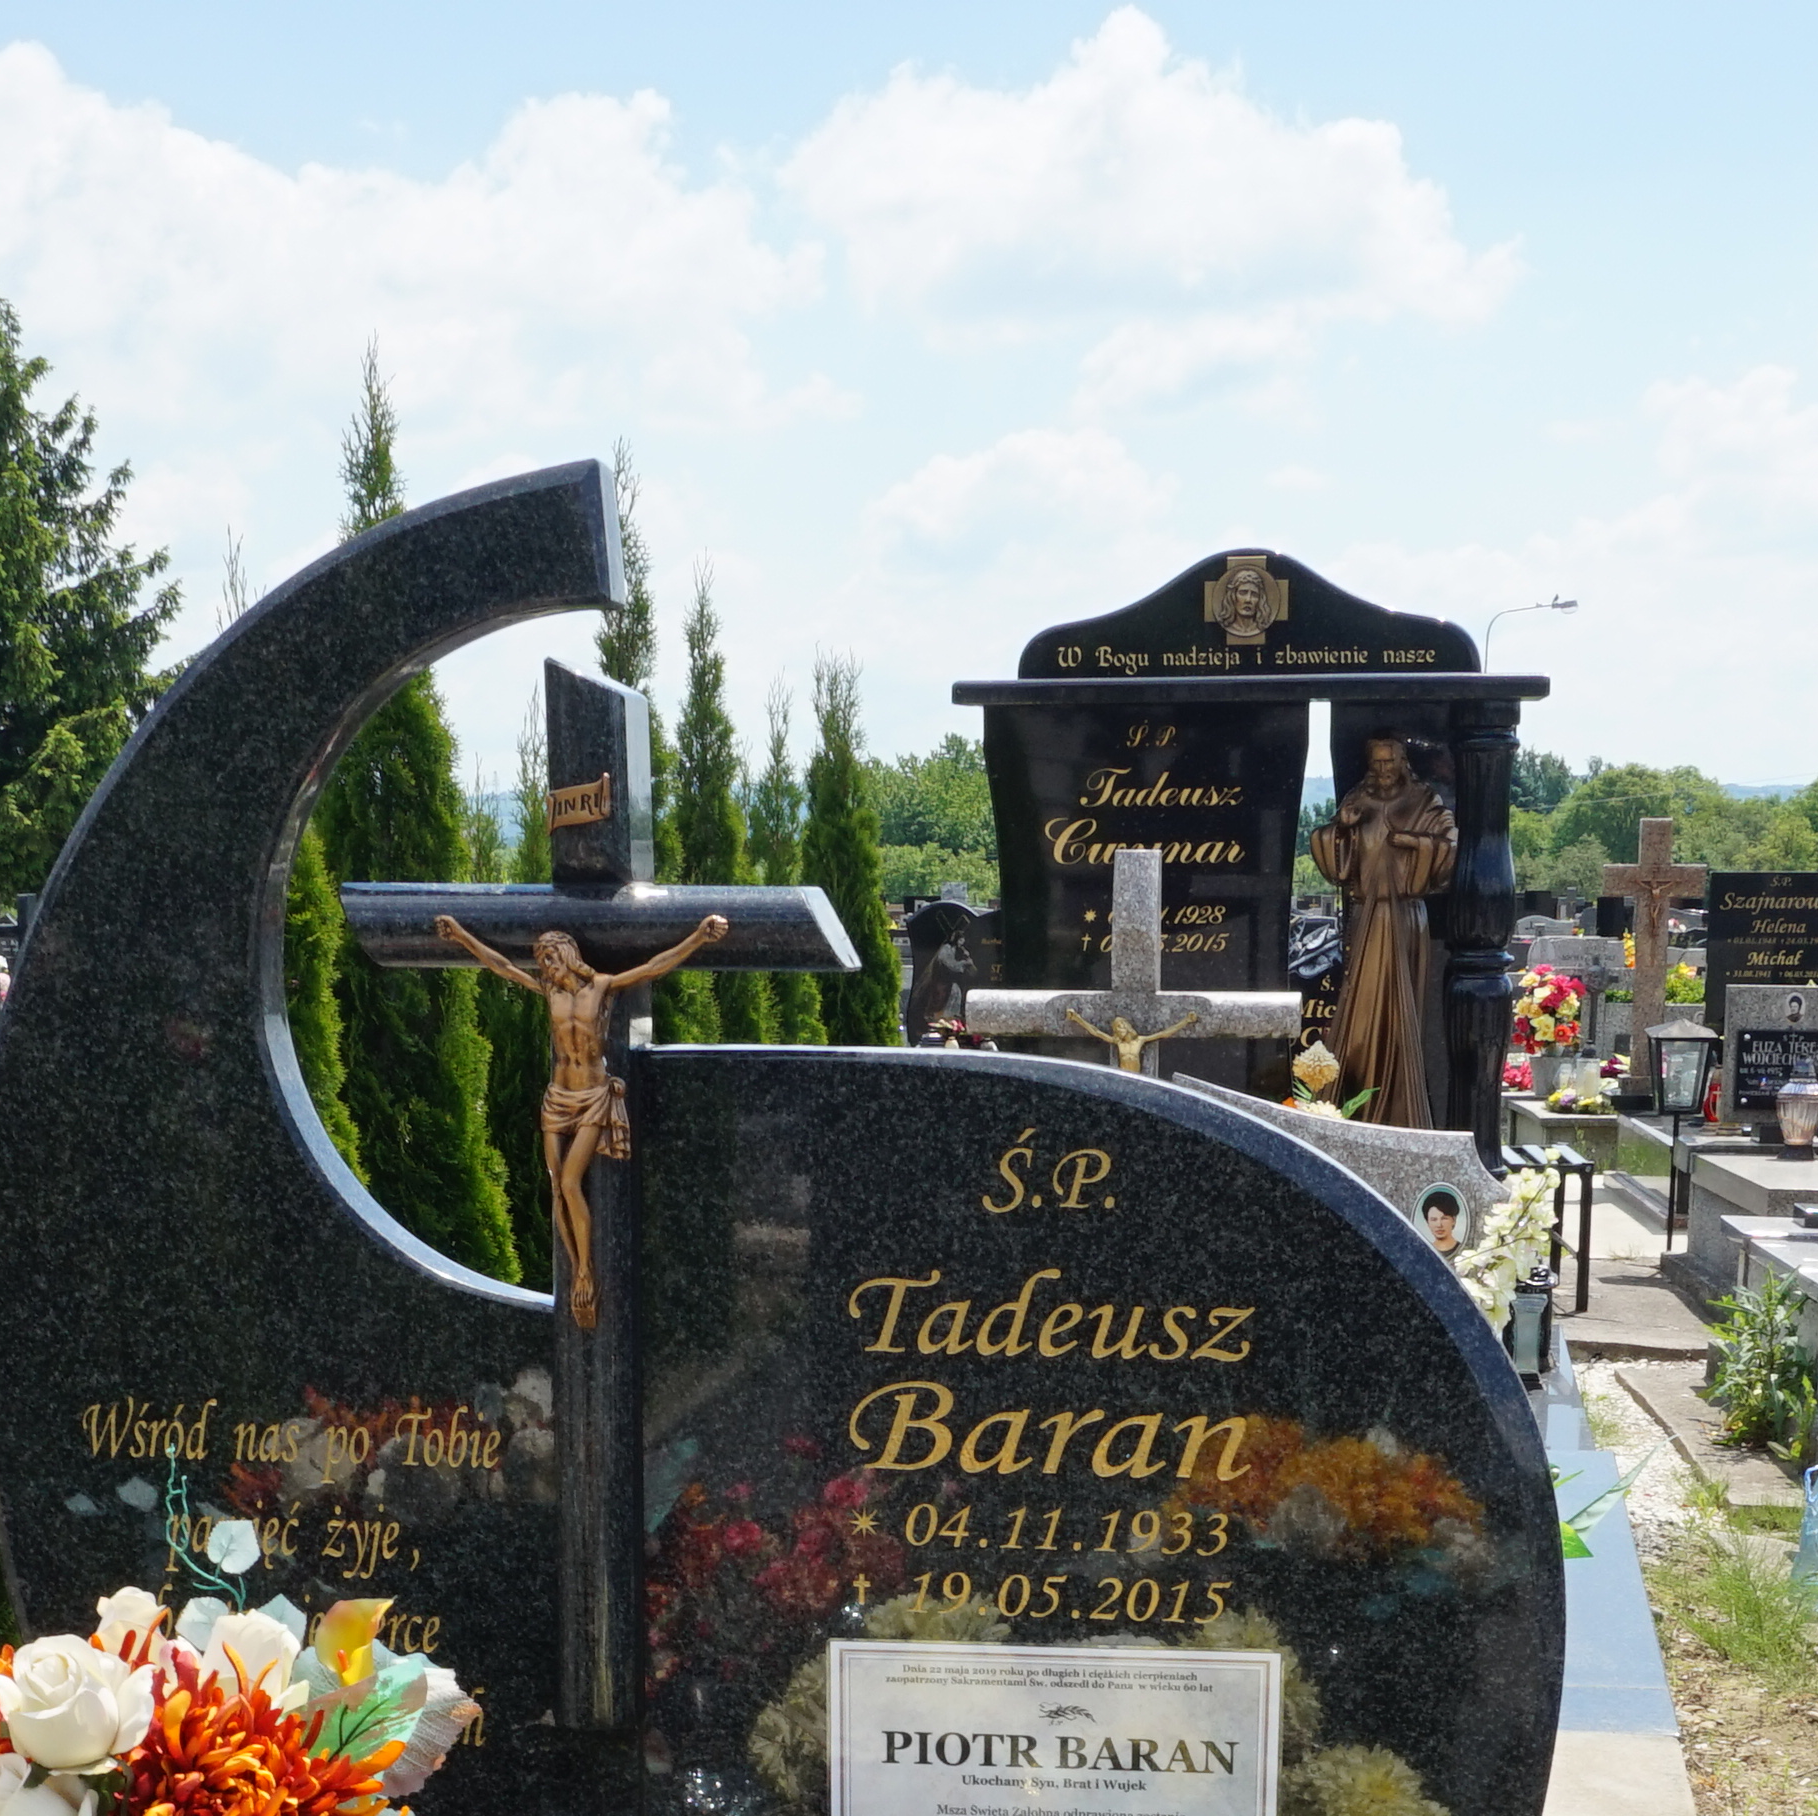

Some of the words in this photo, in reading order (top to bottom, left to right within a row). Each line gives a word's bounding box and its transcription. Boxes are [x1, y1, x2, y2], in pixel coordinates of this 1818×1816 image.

[1057, 646, 1082, 667] W
[1095, 646, 1149, 675] Bogu
[1162, 644, 1241, 671] nadzieja
[1256, 646, 1263, 666] i
[1275, 644, 1369, 665] zbawienie
[1383, 647, 1436, 664] nasze
[1079, 767, 1244, 808] Tadeusz
[1750, 918, 1807, 934] Helena
[1746, 950, 1804, 966] Michał
[1752, 1041, 1782, 1053] ELIZA
[848, 1268, 1255, 1362] Tadeusz
[82, 1396, 217, 1461] Wśród
[234, 1418, 300, 1464] nas
[320, 1422, 370, 1484] po
[394, 1405, 502, 1469] Tobie
[848, 1380, 1253, 1482] Baran
[165, 1501, 301, 1572] paięć
[904, 1502, 1230, 1557] 04.11.1933
[910, 1571, 1233, 1625] 19.05.2015
[885, 1675, 948, 1687] zaopatrzony
[950, 1676, 1027, 1687] Sakramentami
[1092, 1679, 1105, 1690] do
[1107, 1680, 1133, 1691] Pana
[1150, 1681, 1182, 1692] wieku
[1183, 1683, 1197, 1692] 60
[1199, 1682, 1213, 1693] lat
[903, 1664, 928, 1674] Dnia
[929, 1666, 942, 1675] 22
[944, 1665, 970, 1677] maja
[972, 1668, 997, 1677] 2019
[999, 1666, 1025, 1677] roku
[1026, 1669, 1040, 1680] po
[1042, 1667, 1080, 1681] długich
[1089, 1670, 1131, 1682] ciężkich
[1133, 1671, 1198, 1684] cierpieniach
[881, 1730, 1043, 1769] PIOTR
[1055, 1735, 1240, 1775] BARAN
[961, 1774, 1026, 1790] Ukochany
[1030, 1776, 1059, 1790] Syn,
[1063, 1778, 1092, 1790] Brat
[1102, 1779, 1148, 1794] Wujek
[937, 1804, 967, 1816] Msza
